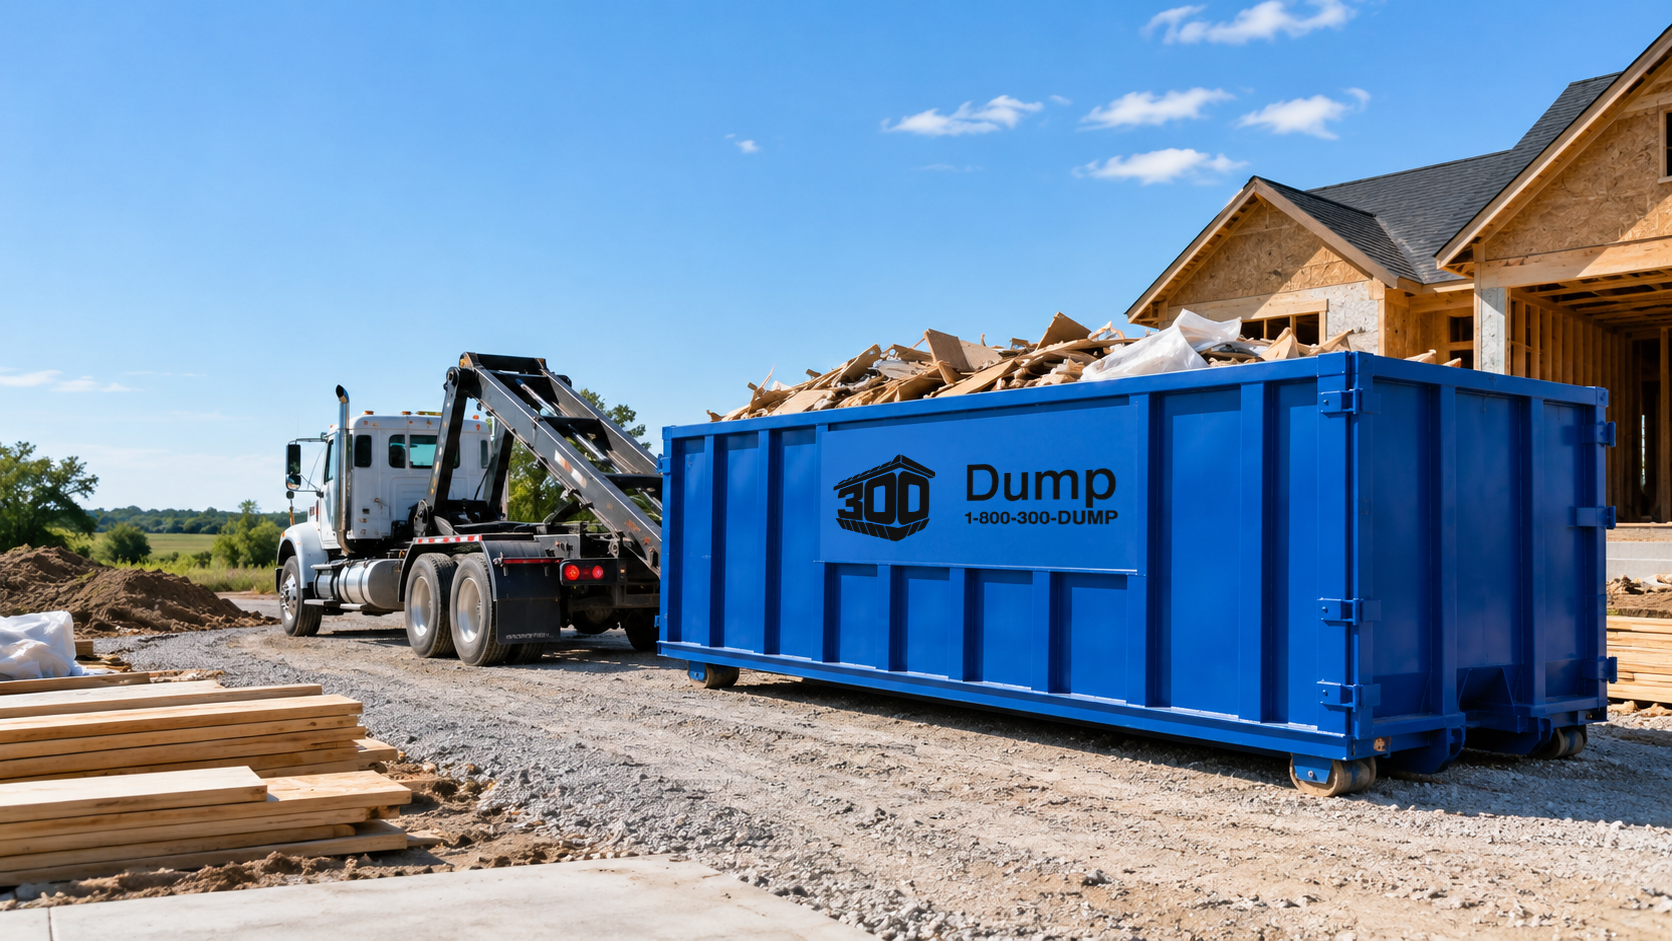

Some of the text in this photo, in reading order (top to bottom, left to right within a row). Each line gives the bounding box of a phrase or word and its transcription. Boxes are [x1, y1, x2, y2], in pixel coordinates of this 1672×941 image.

[837, 470, 930, 525] 300
[966, 463, 1117, 508] Dump
[964, 510, 1119, 525] 1-800-300-DUMP
